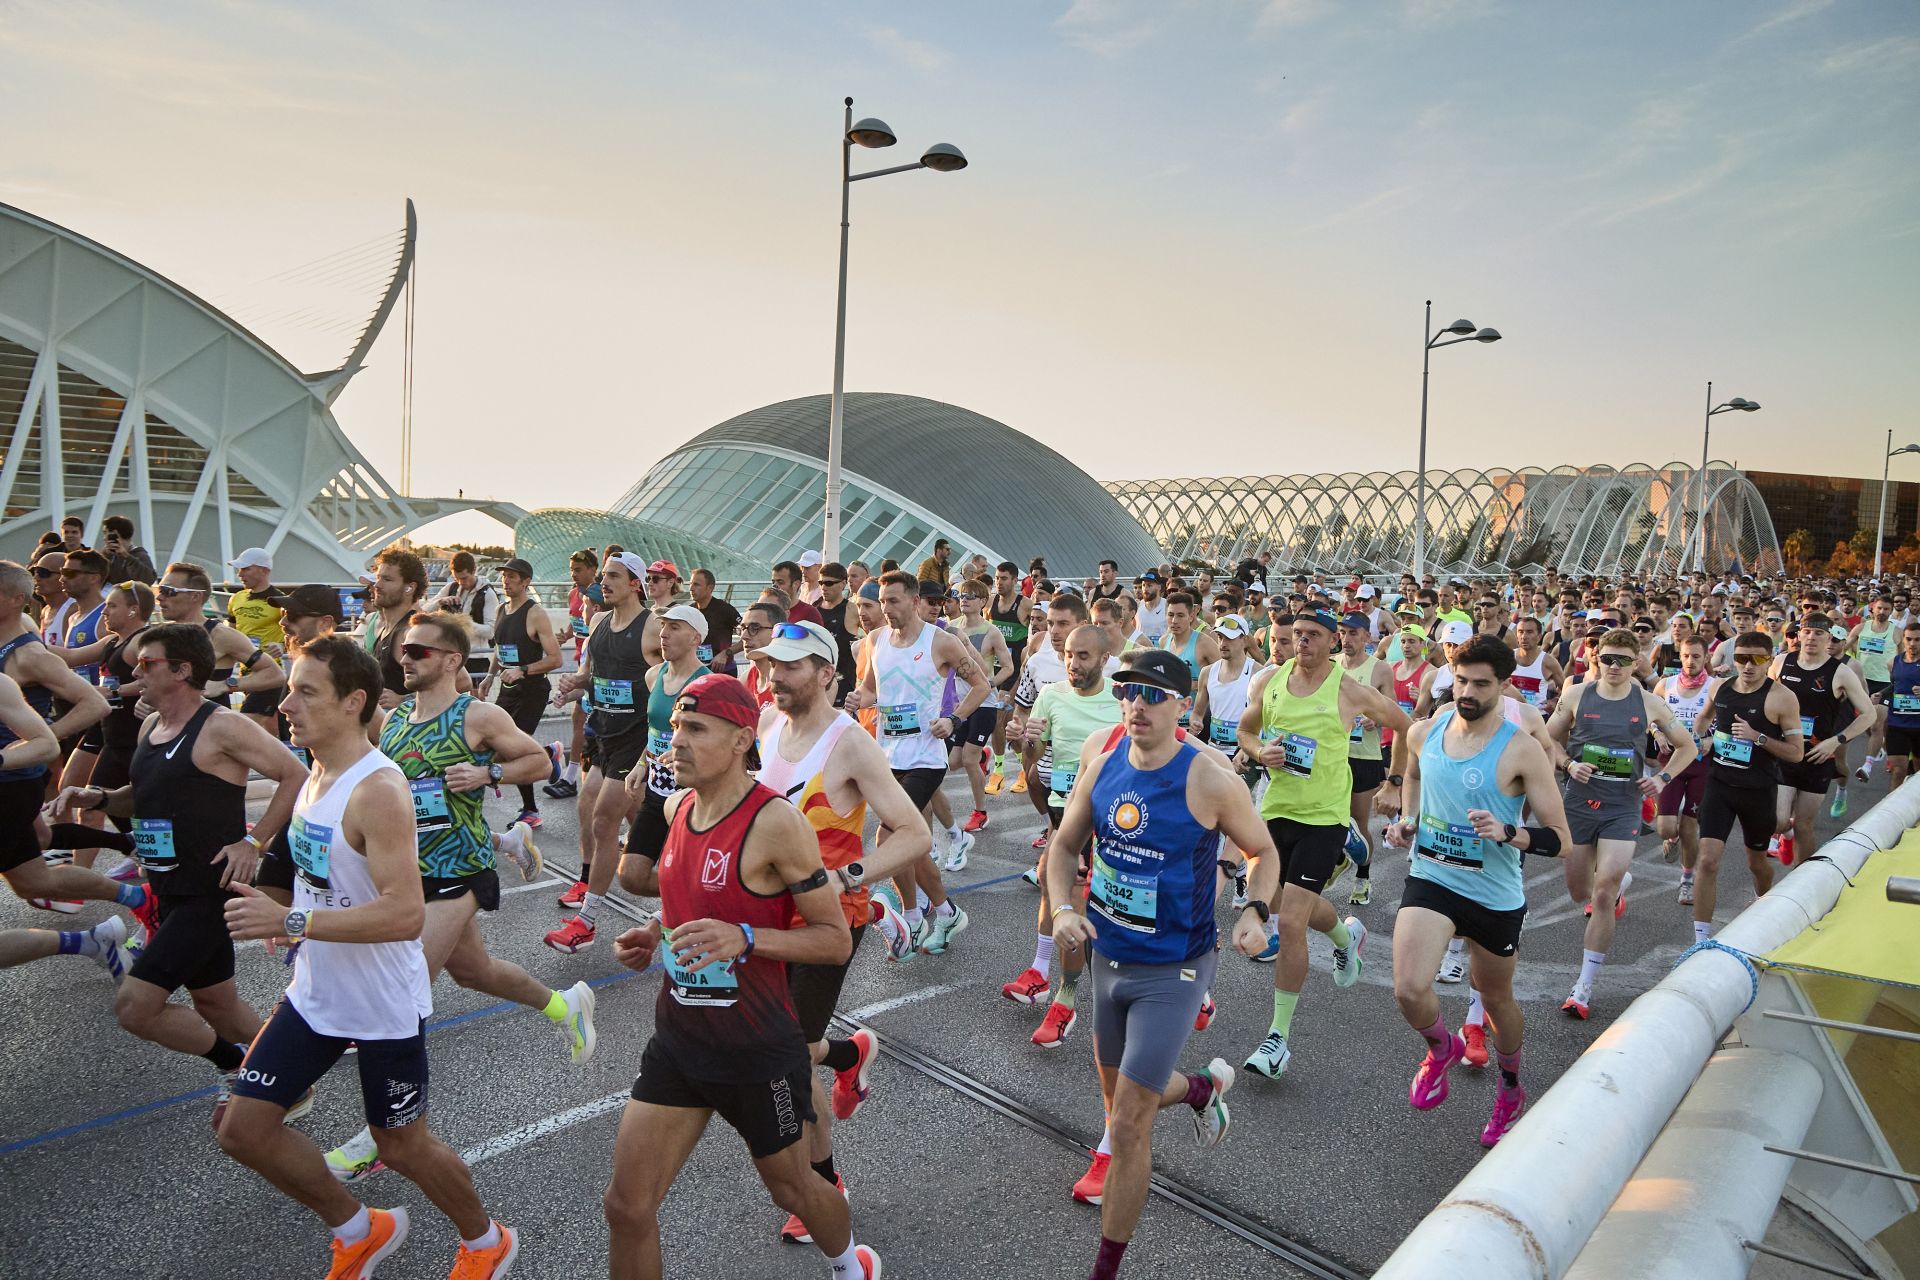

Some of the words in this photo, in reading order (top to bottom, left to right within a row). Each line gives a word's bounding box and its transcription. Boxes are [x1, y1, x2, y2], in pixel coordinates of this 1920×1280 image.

[601, 688, 620, 696] 33170
[888, 715, 903, 723] 4480
[1434, 831, 1463, 847] 10163
[1105, 848, 1121, 858] NEW
[1122, 853, 1142, 865] YORK
[1118, 843, 1165, 861] RUNNERS
[1430, 842, 1448, 853] Jose
[1449, 847, 1468, 857] Luis
[1103, 879, 1133, 900] 33342
[1105, 894, 1128, 911] Myles
[674, 970, 697, 985] XIMO
[700, 973, 709, 984] A
[237, 1067, 277, 1086] ROU
